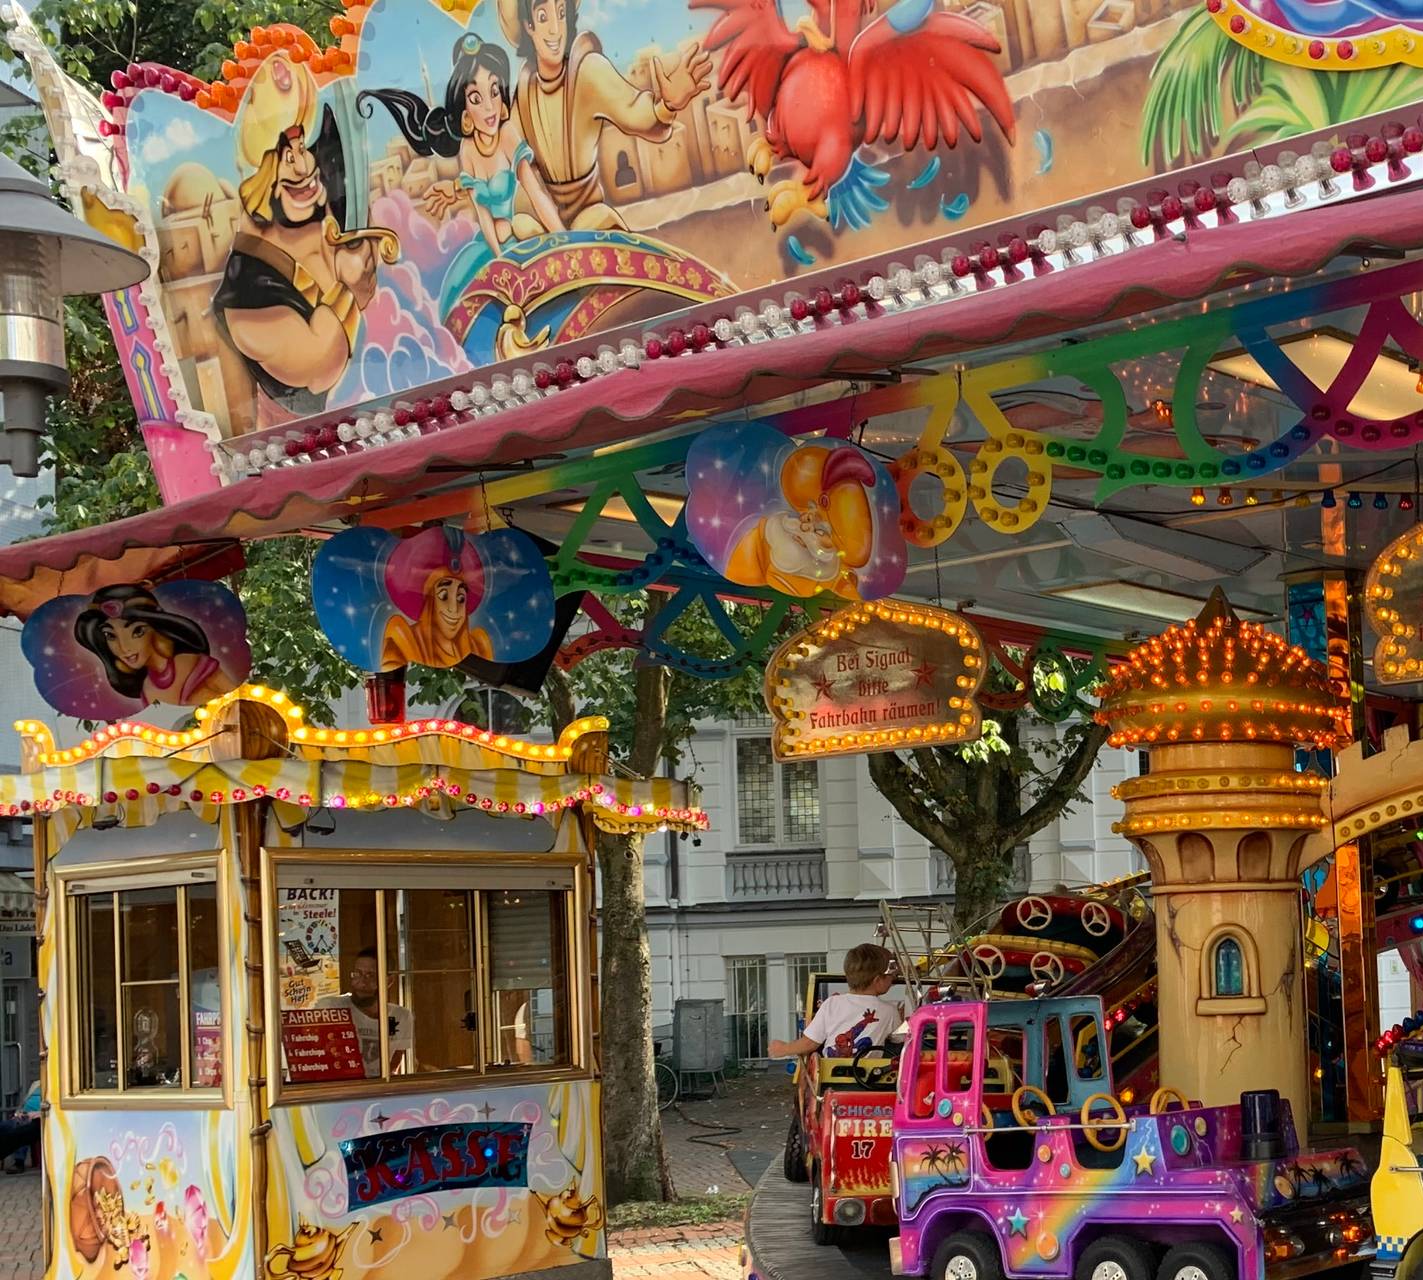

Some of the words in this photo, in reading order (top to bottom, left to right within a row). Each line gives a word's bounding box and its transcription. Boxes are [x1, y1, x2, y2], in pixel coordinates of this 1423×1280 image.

[837, 653, 860, 673] Bei
[865, 647, 912, 670] Signal
[858, 677, 889, 696] bitte
[810, 707, 877, 729] Fahrbahn
[883, 700, 941, 721] räumen!
[287, 888, 335, 900] BACK!
[303, 908, 337, 920] Steele!
[281, 1009, 350, 1025] FAHRPREIS
[836, 1105, 895, 1117] CHICAG
[838, 1119, 894, 1138] FIRE
[851, 1139, 876, 1160] 17
[352, 1129, 522, 1201] KASSE
